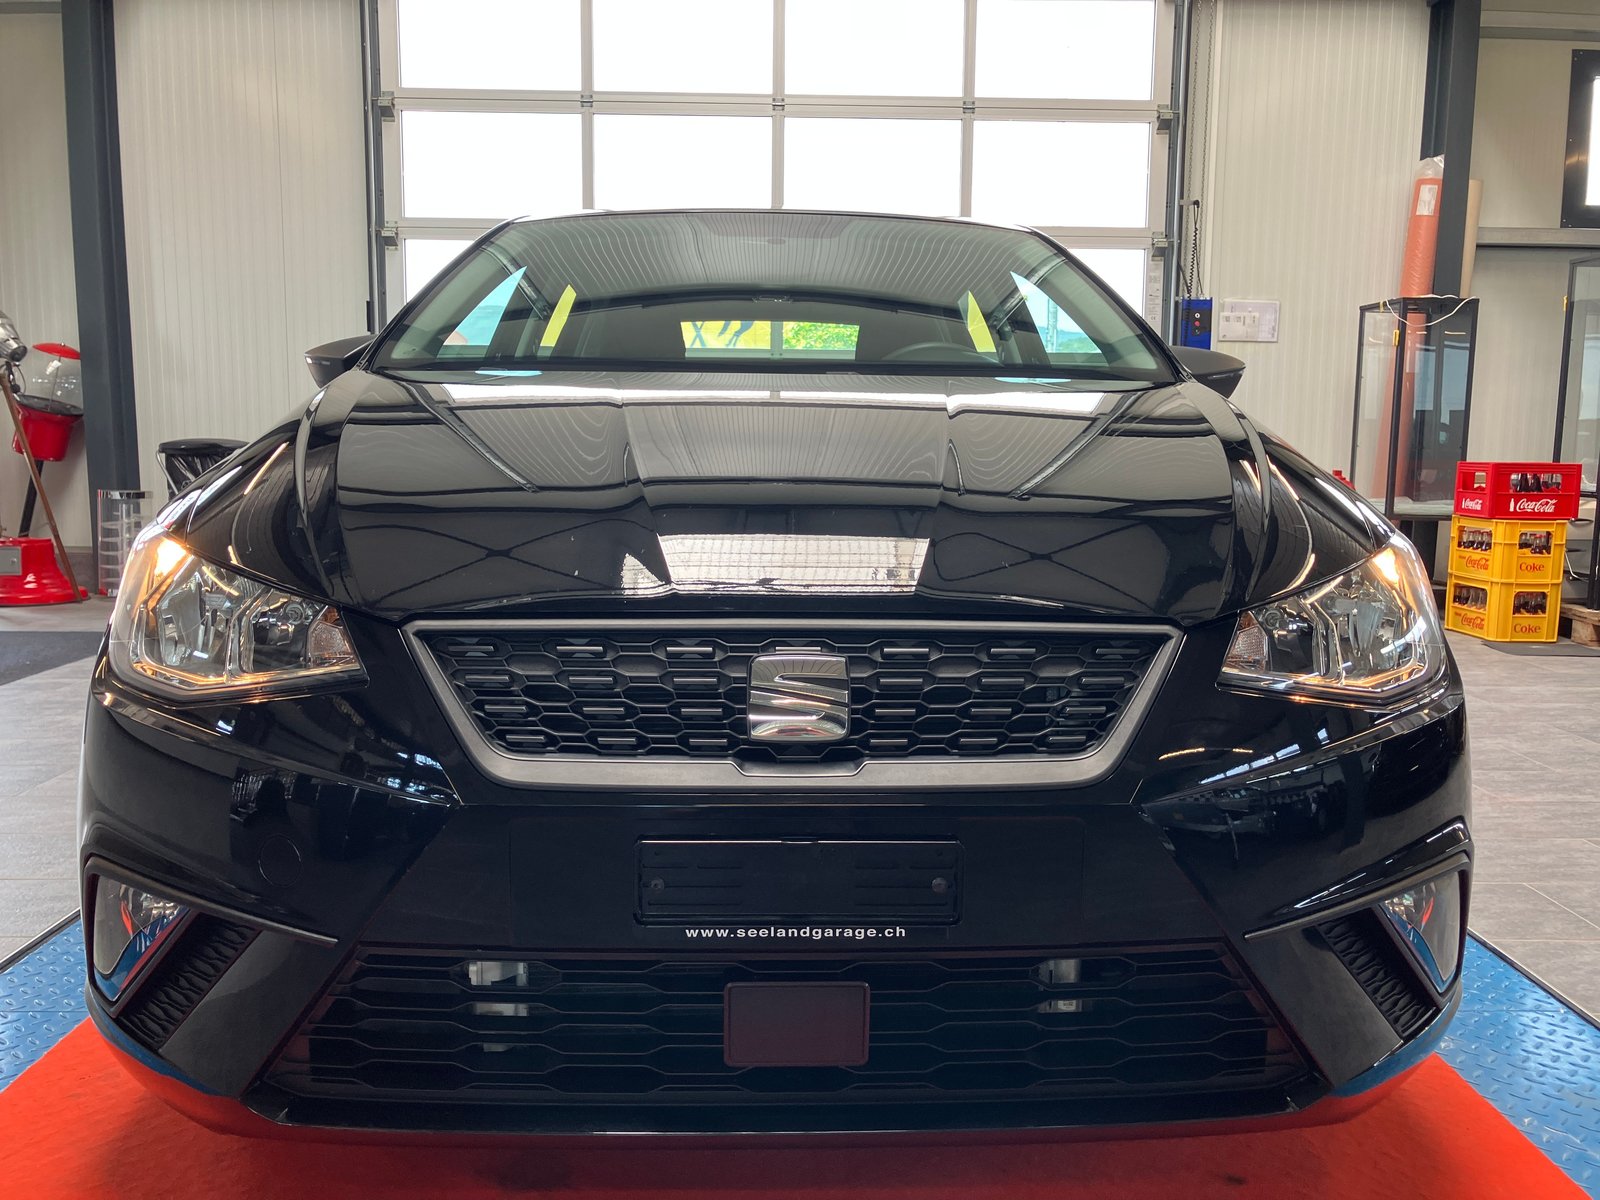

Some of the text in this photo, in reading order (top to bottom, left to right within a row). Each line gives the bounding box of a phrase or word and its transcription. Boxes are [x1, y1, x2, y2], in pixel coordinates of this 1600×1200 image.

[1519, 561, 1545, 573] Coke
[1513, 623, 1541, 634] Coke
[685, 926, 907, 940] www.seelandgarage.ch
